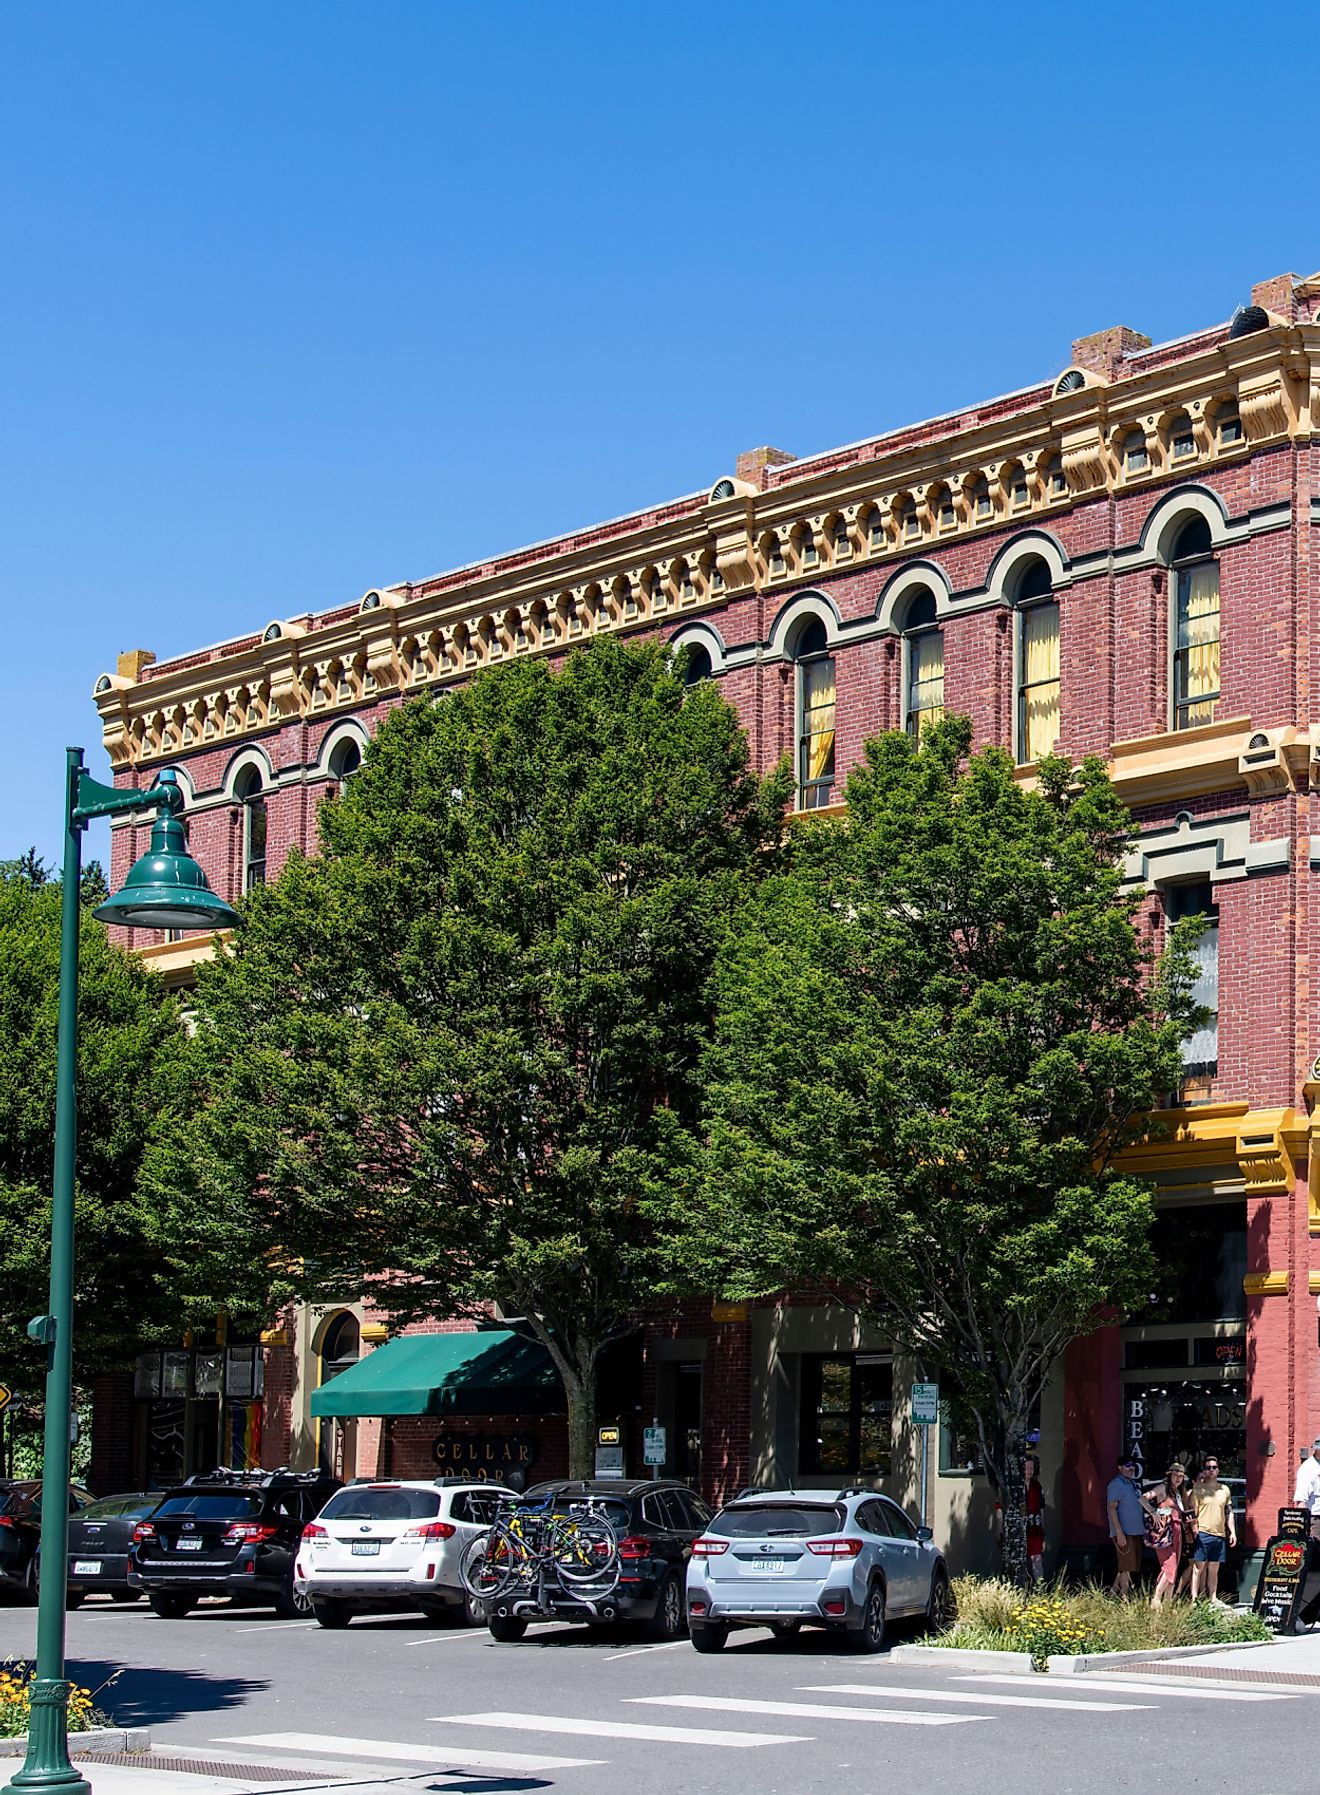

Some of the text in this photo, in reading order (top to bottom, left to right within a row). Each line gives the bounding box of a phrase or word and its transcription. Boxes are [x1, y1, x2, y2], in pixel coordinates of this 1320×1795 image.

[1216, 1346, 1242, 1359] OPEN
[914, 1385, 923, 1394] 15
[601, 1431, 618, 1440] OPEN
[436, 1443, 528, 1461] CELLAR
[445, 1466, 504, 1481] DOOR
[1275, 1550, 1301, 1558] CELLAR
[1276, 1557, 1297, 1566] DOOR
